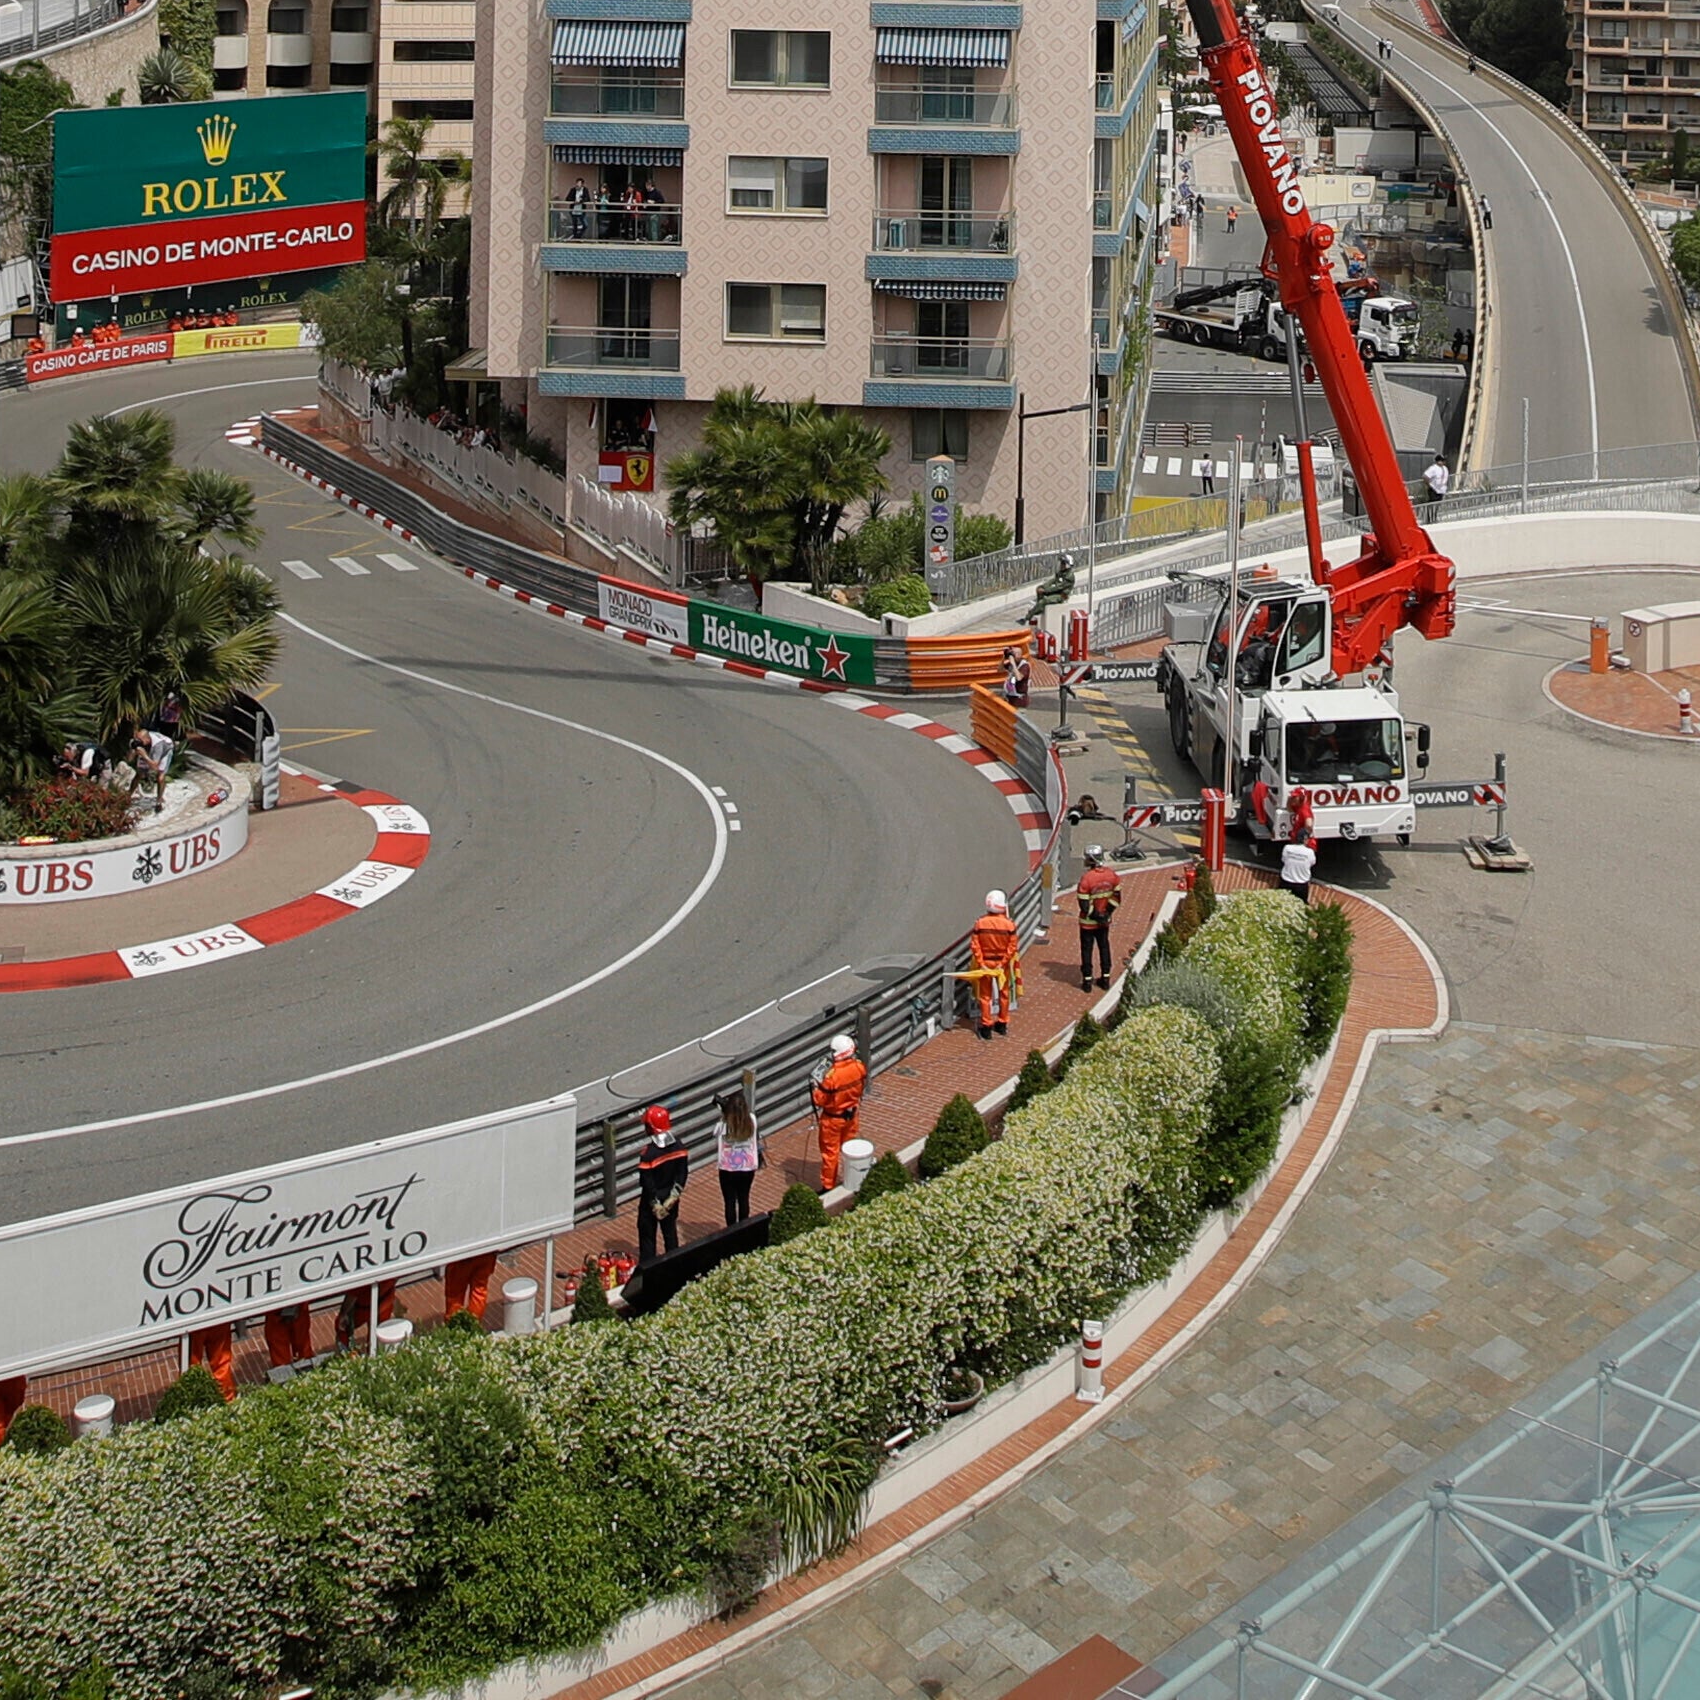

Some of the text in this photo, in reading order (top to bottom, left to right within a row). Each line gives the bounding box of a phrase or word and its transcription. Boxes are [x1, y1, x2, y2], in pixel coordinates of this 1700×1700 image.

[1236, 67, 1305, 216] PIOVANO
[140, 170, 288, 217] ROLEX
[71, 221, 354, 276] CASINO DE MONTE-CARLO
[123, 307, 169, 327] ROLEX
[240, 291, 288, 308] ROLEX
[31, 339, 168, 375] CASINO CAFE DE PARIS
[204, 329, 268, 350] PIRELLI
[607, 588, 653, 617] MONACO
[702, 613, 811, 670] Heineken
[168, 826, 221, 875] UBS
[14, 858, 94, 897] UBS
[349, 861, 397, 891] UBS
[171, 929, 247, 958] UBS
[142, 1171, 426, 1290] Fairmont
[137, 1230, 429, 1328] MONTE CARLO
